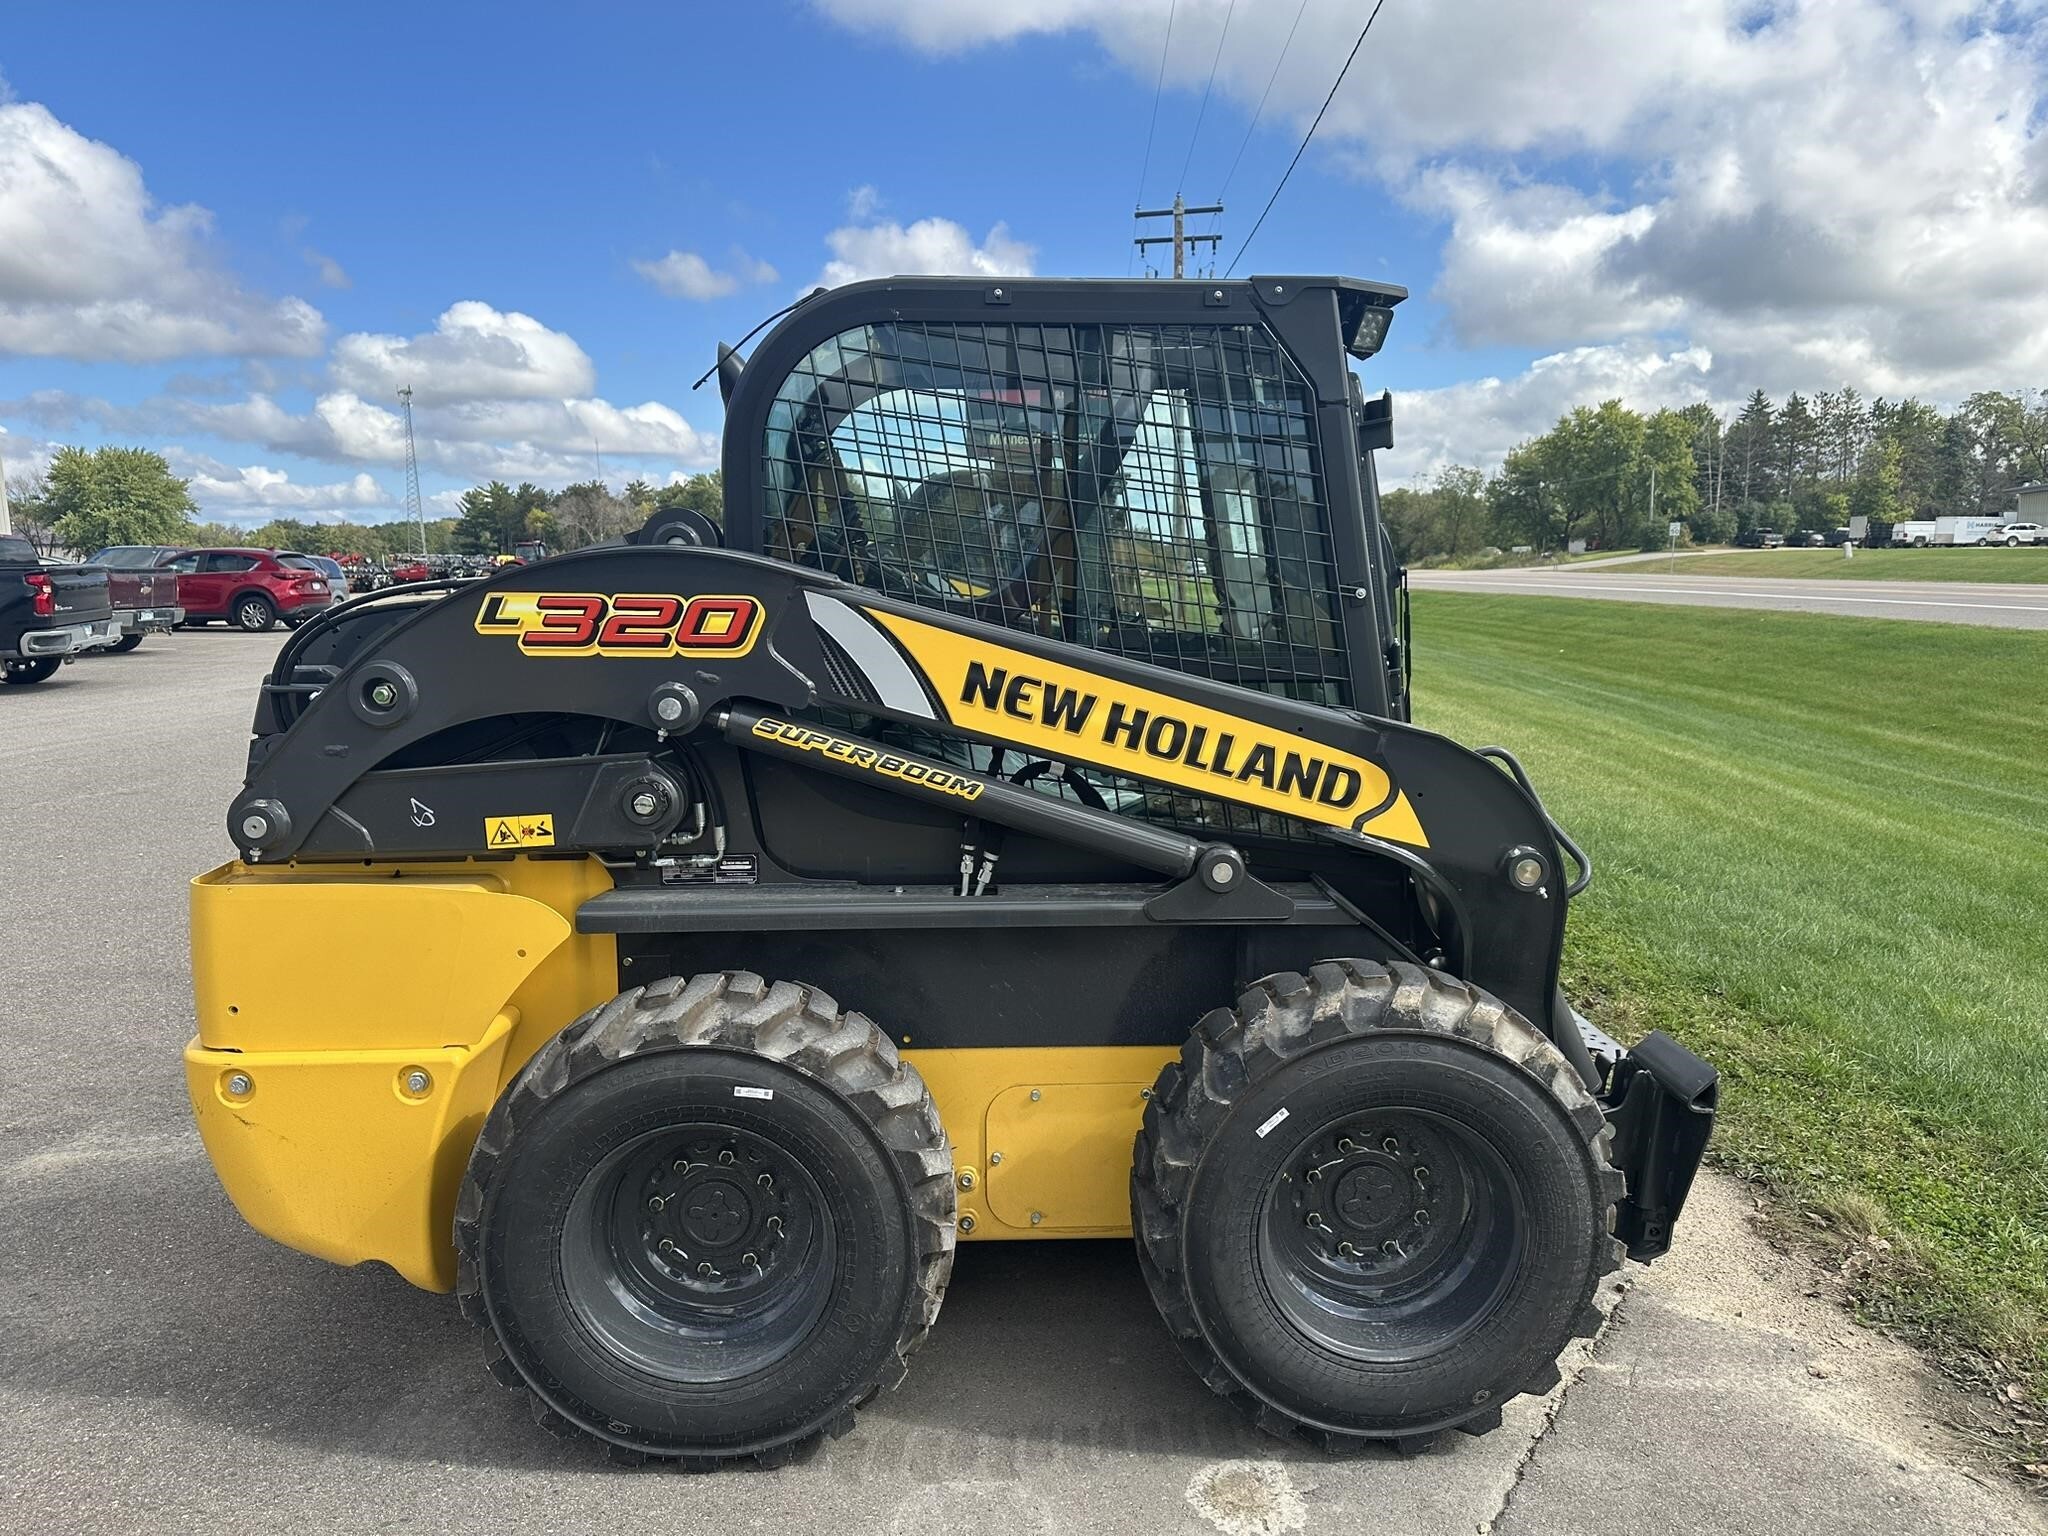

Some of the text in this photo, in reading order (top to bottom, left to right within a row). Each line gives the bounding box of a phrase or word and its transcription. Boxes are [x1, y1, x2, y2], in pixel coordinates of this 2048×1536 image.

[474, 592, 766, 658] L320
[752, 717, 985, 801] SUPER BOOM
[959, 659, 1363, 810] NEW HOLLAND
[1296, 1041, 1433, 1076] XD2010
[788, 1079, 886, 1179] XD2010
